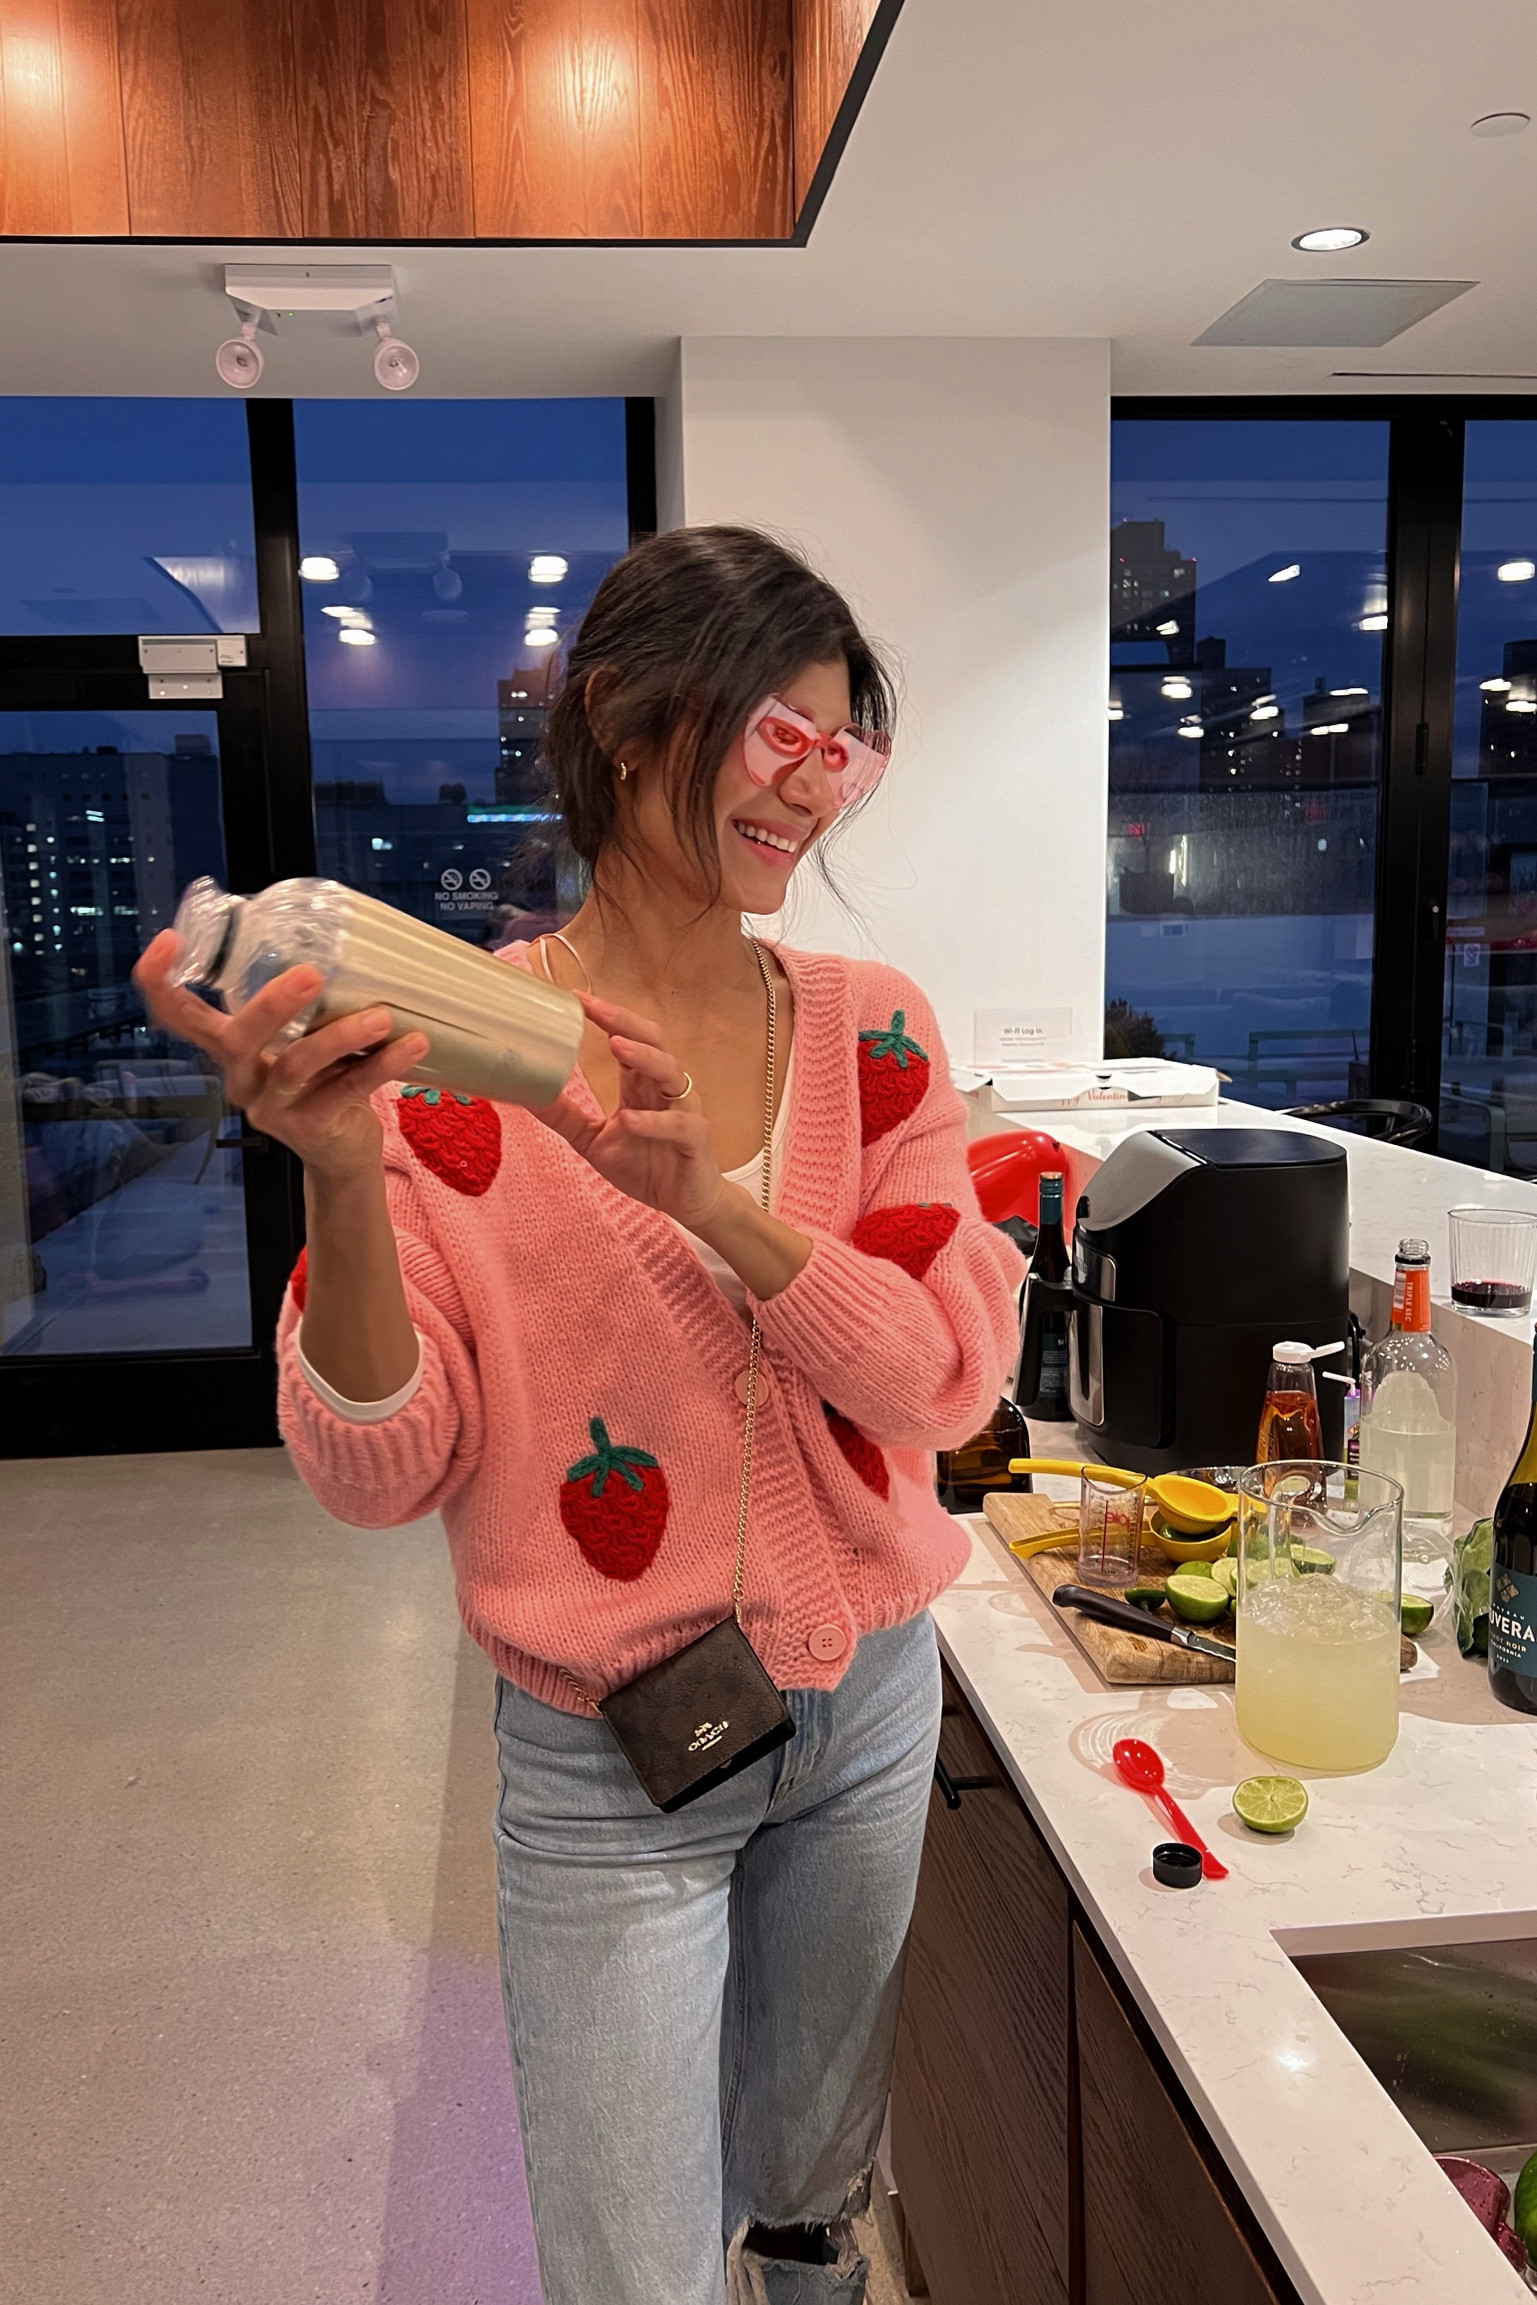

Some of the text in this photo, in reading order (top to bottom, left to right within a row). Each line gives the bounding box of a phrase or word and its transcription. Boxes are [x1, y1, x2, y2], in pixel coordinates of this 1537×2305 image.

[434, 892, 498, 900] NO SMOKING
[440, 902, 494, 910] NO VAPING
[1021, 1027, 1034, 1035] Log
[1087, 1089, 1126, 1101] Valentin
[1489, 1609, 1536, 1642] UVERA
[1506, 1640, 1527, 1652] NOIR
[688, 1720, 729, 1752] COACH
